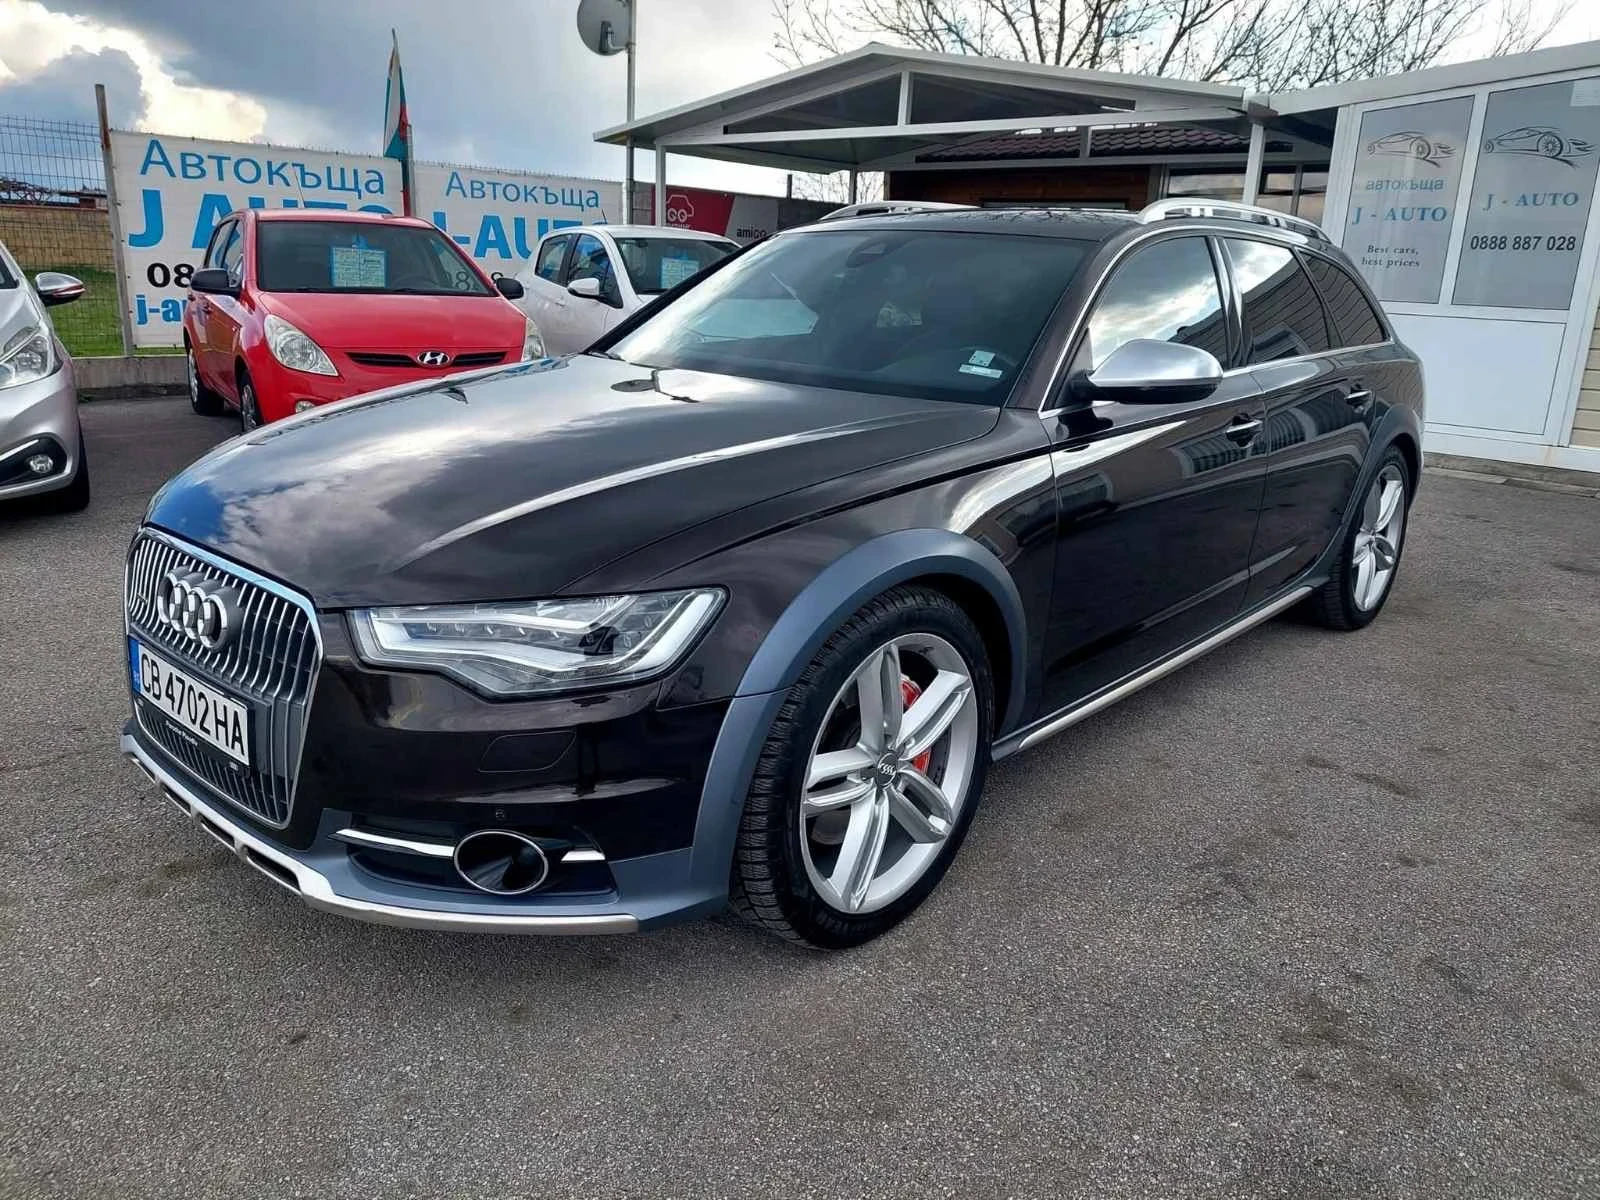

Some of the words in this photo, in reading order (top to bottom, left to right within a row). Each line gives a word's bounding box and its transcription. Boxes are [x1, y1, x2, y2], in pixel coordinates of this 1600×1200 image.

[140, 139, 384, 199] Автокъща
[446, 171, 600, 212] Автокъща
[1366, 179, 1443, 192] автокъща
[1482, 193, 1494, 211] J
[1515, 192, 1579, 206] AUTO
[128, 189, 164, 248] J
[1352, 207, 1362, 225] J
[1384, 206, 1447, 221] AUTO
[1367, 245, 1389, 254] Best
[1470, 235, 1508, 250] 0888
[1512, 235, 1542, 250] 887
[1546, 235, 1577, 251] 028
[1386, 257, 1421, 269] prices
[136, 294, 189, 325] j-a
